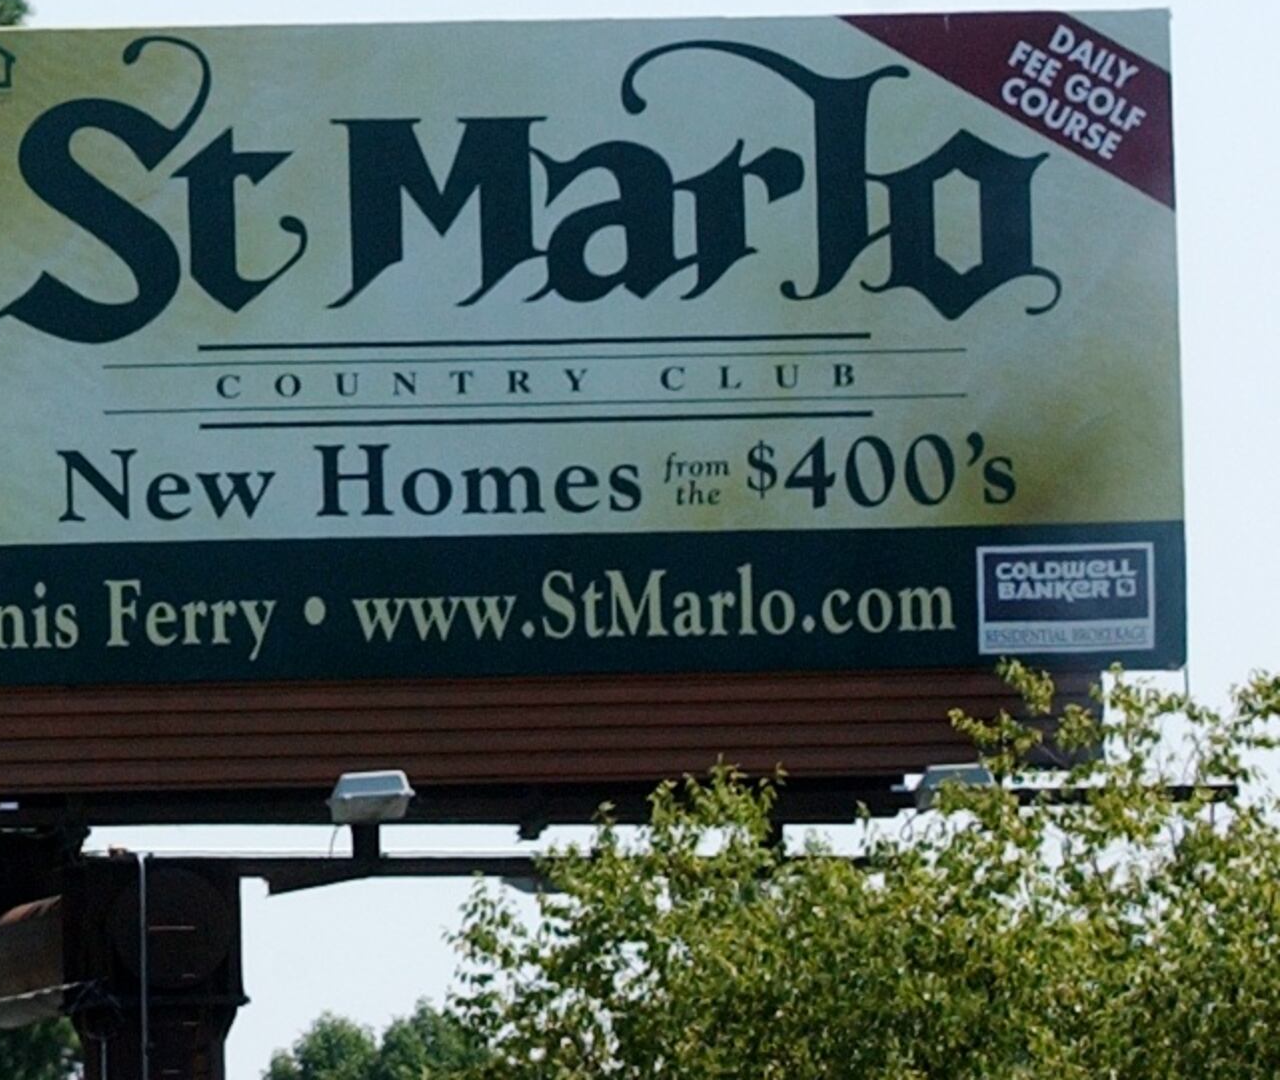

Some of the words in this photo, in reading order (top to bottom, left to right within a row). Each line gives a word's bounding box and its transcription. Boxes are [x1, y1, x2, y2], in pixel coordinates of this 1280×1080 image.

[1007, 40, 1063, 87] FEE
[1064, 73, 1147, 132] GOLF
[1048, 24, 1139, 88] DAILY
[1001, 77, 1123, 160] COURSE
[326, 40, 1062, 322] Marlo
[215, 368, 588, 400] COUNTRY
[659, 363, 856, 392] CLUB
[56, 449, 276, 521] New
[313, 442, 642, 517] Homes
[663, 451, 731, 484] from
[676, 481, 722, 507] the
[746, 431, 1018, 509] $400's
[104, 578, 277, 662] Ferry
[351, 563, 958, 644] www.StMarlo.com
